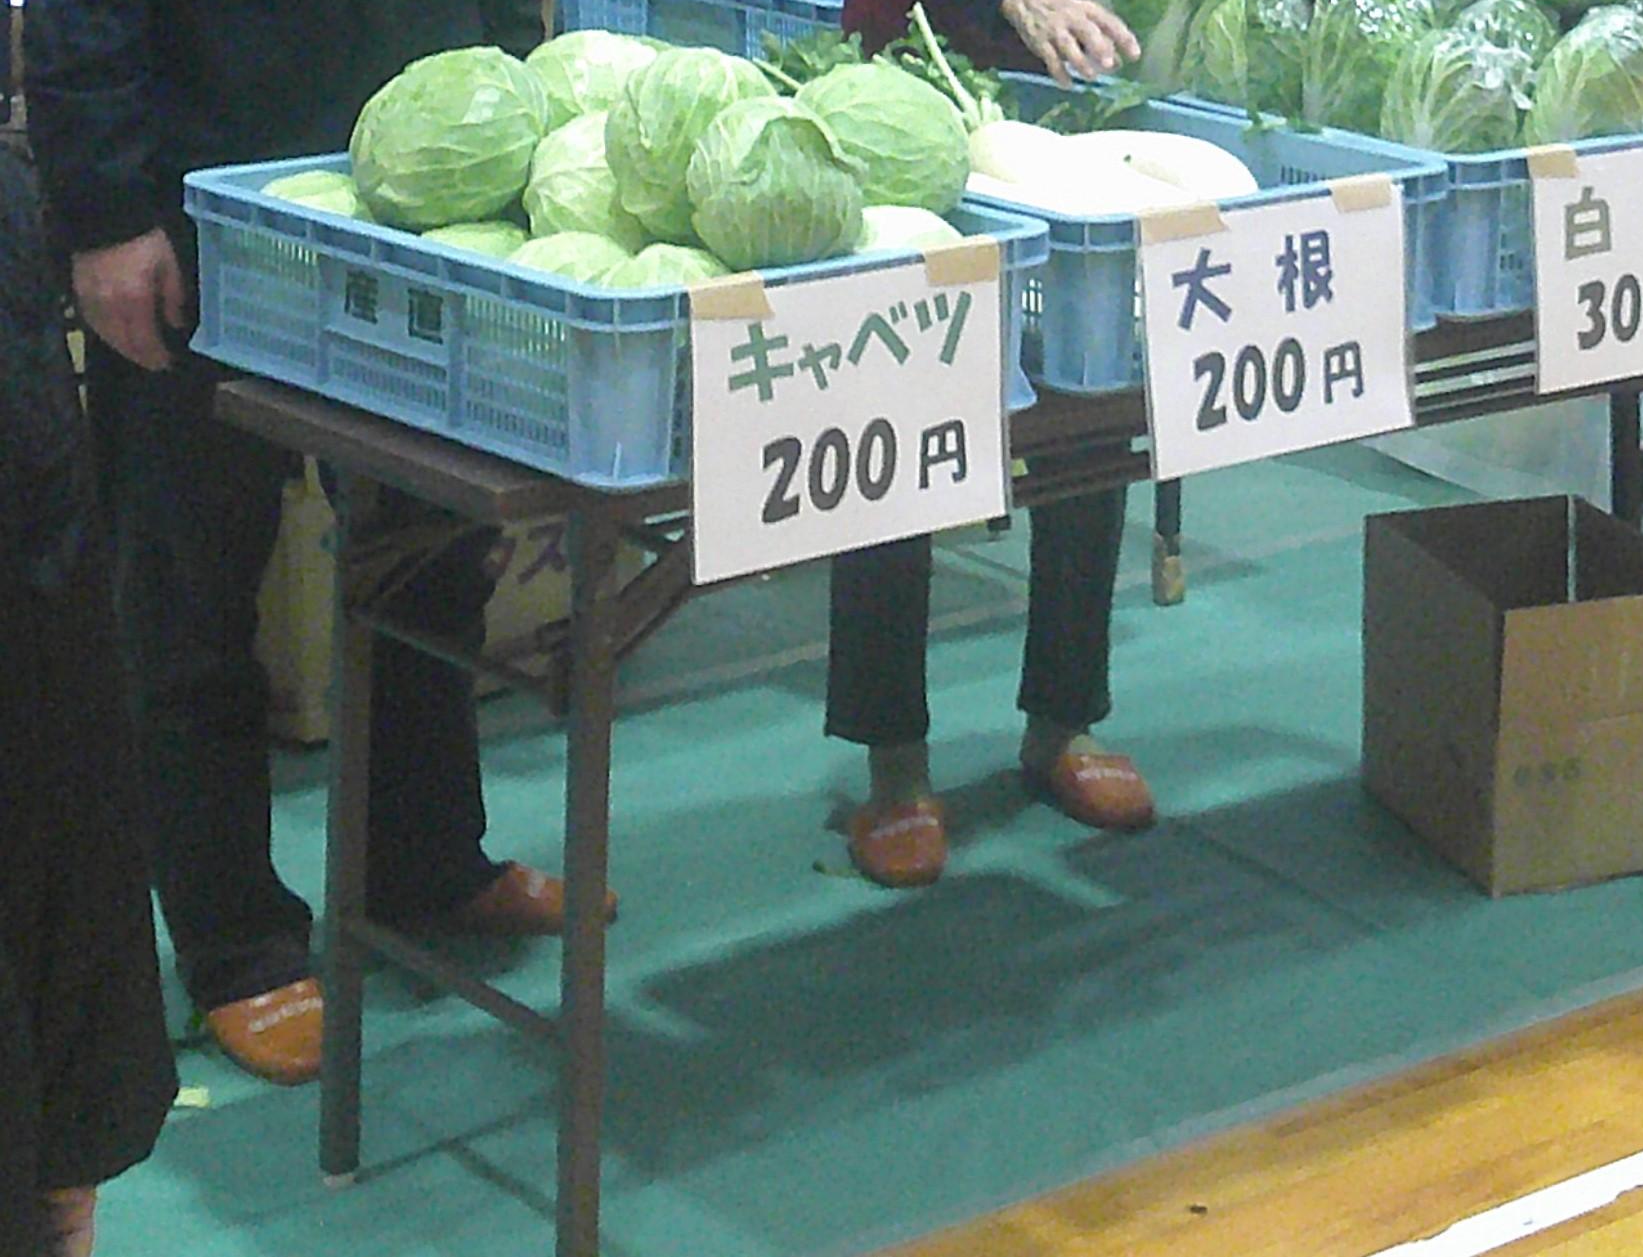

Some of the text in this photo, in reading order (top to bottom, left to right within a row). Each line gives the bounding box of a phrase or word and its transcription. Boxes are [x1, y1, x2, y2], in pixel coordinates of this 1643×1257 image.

[1172, 230, 1333, 330] 大根
[728, 292, 971, 402] キャベツ
[1194, 338, 1364, 431] 200円
[762, 418, 967, 524] 200円
